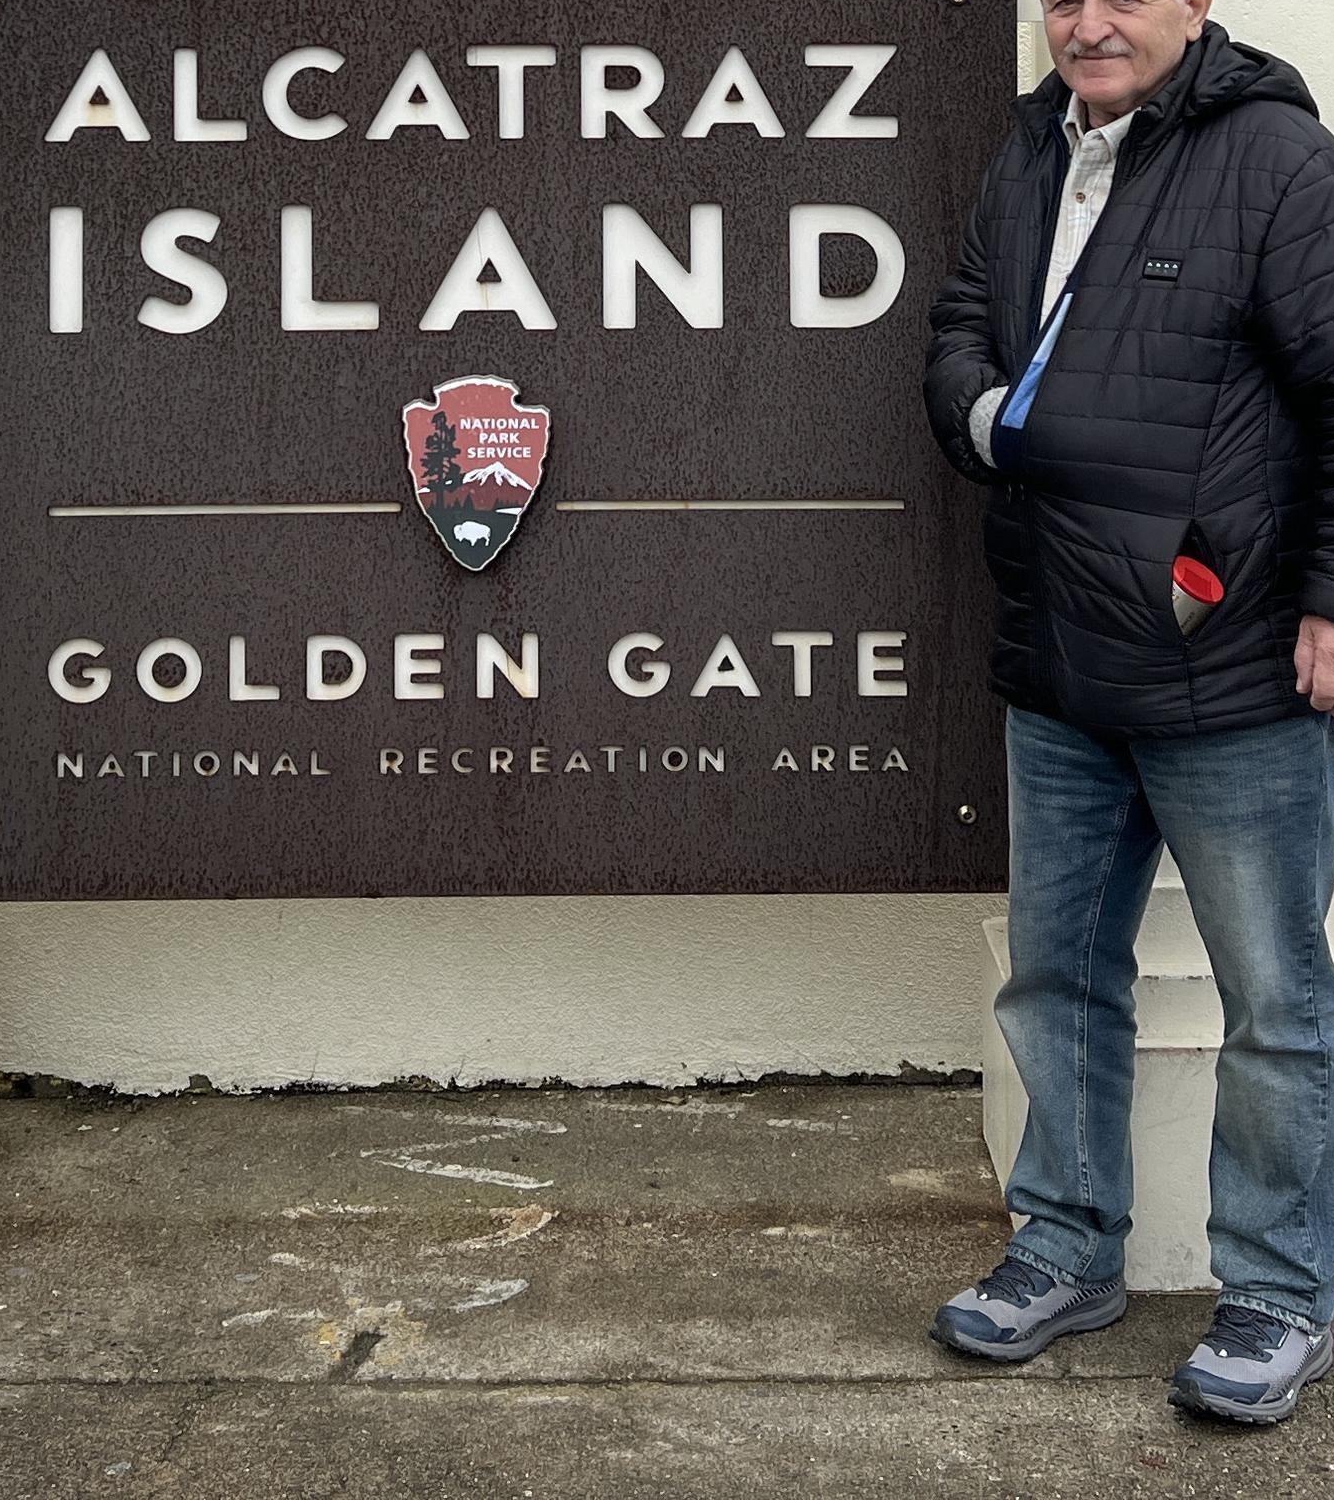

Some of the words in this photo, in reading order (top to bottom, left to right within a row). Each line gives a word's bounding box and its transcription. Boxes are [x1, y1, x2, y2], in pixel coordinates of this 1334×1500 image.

[43, 44, 900, 143] ALCATRAZ
[47, 202, 907, 334] ISLAND
[459, 417, 540, 431] NATIONAL
[479, 431, 520, 445] PARK
[466, 446, 532, 459] SERVICE
[46, 632, 540, 704] GOLDEN
[607, 631, 909, 699] GATE
[56, 750, 331, 780] NATIONAL
[379, 745, 726, 777] RECREATION
[771, 744, 910, 773] AREA
